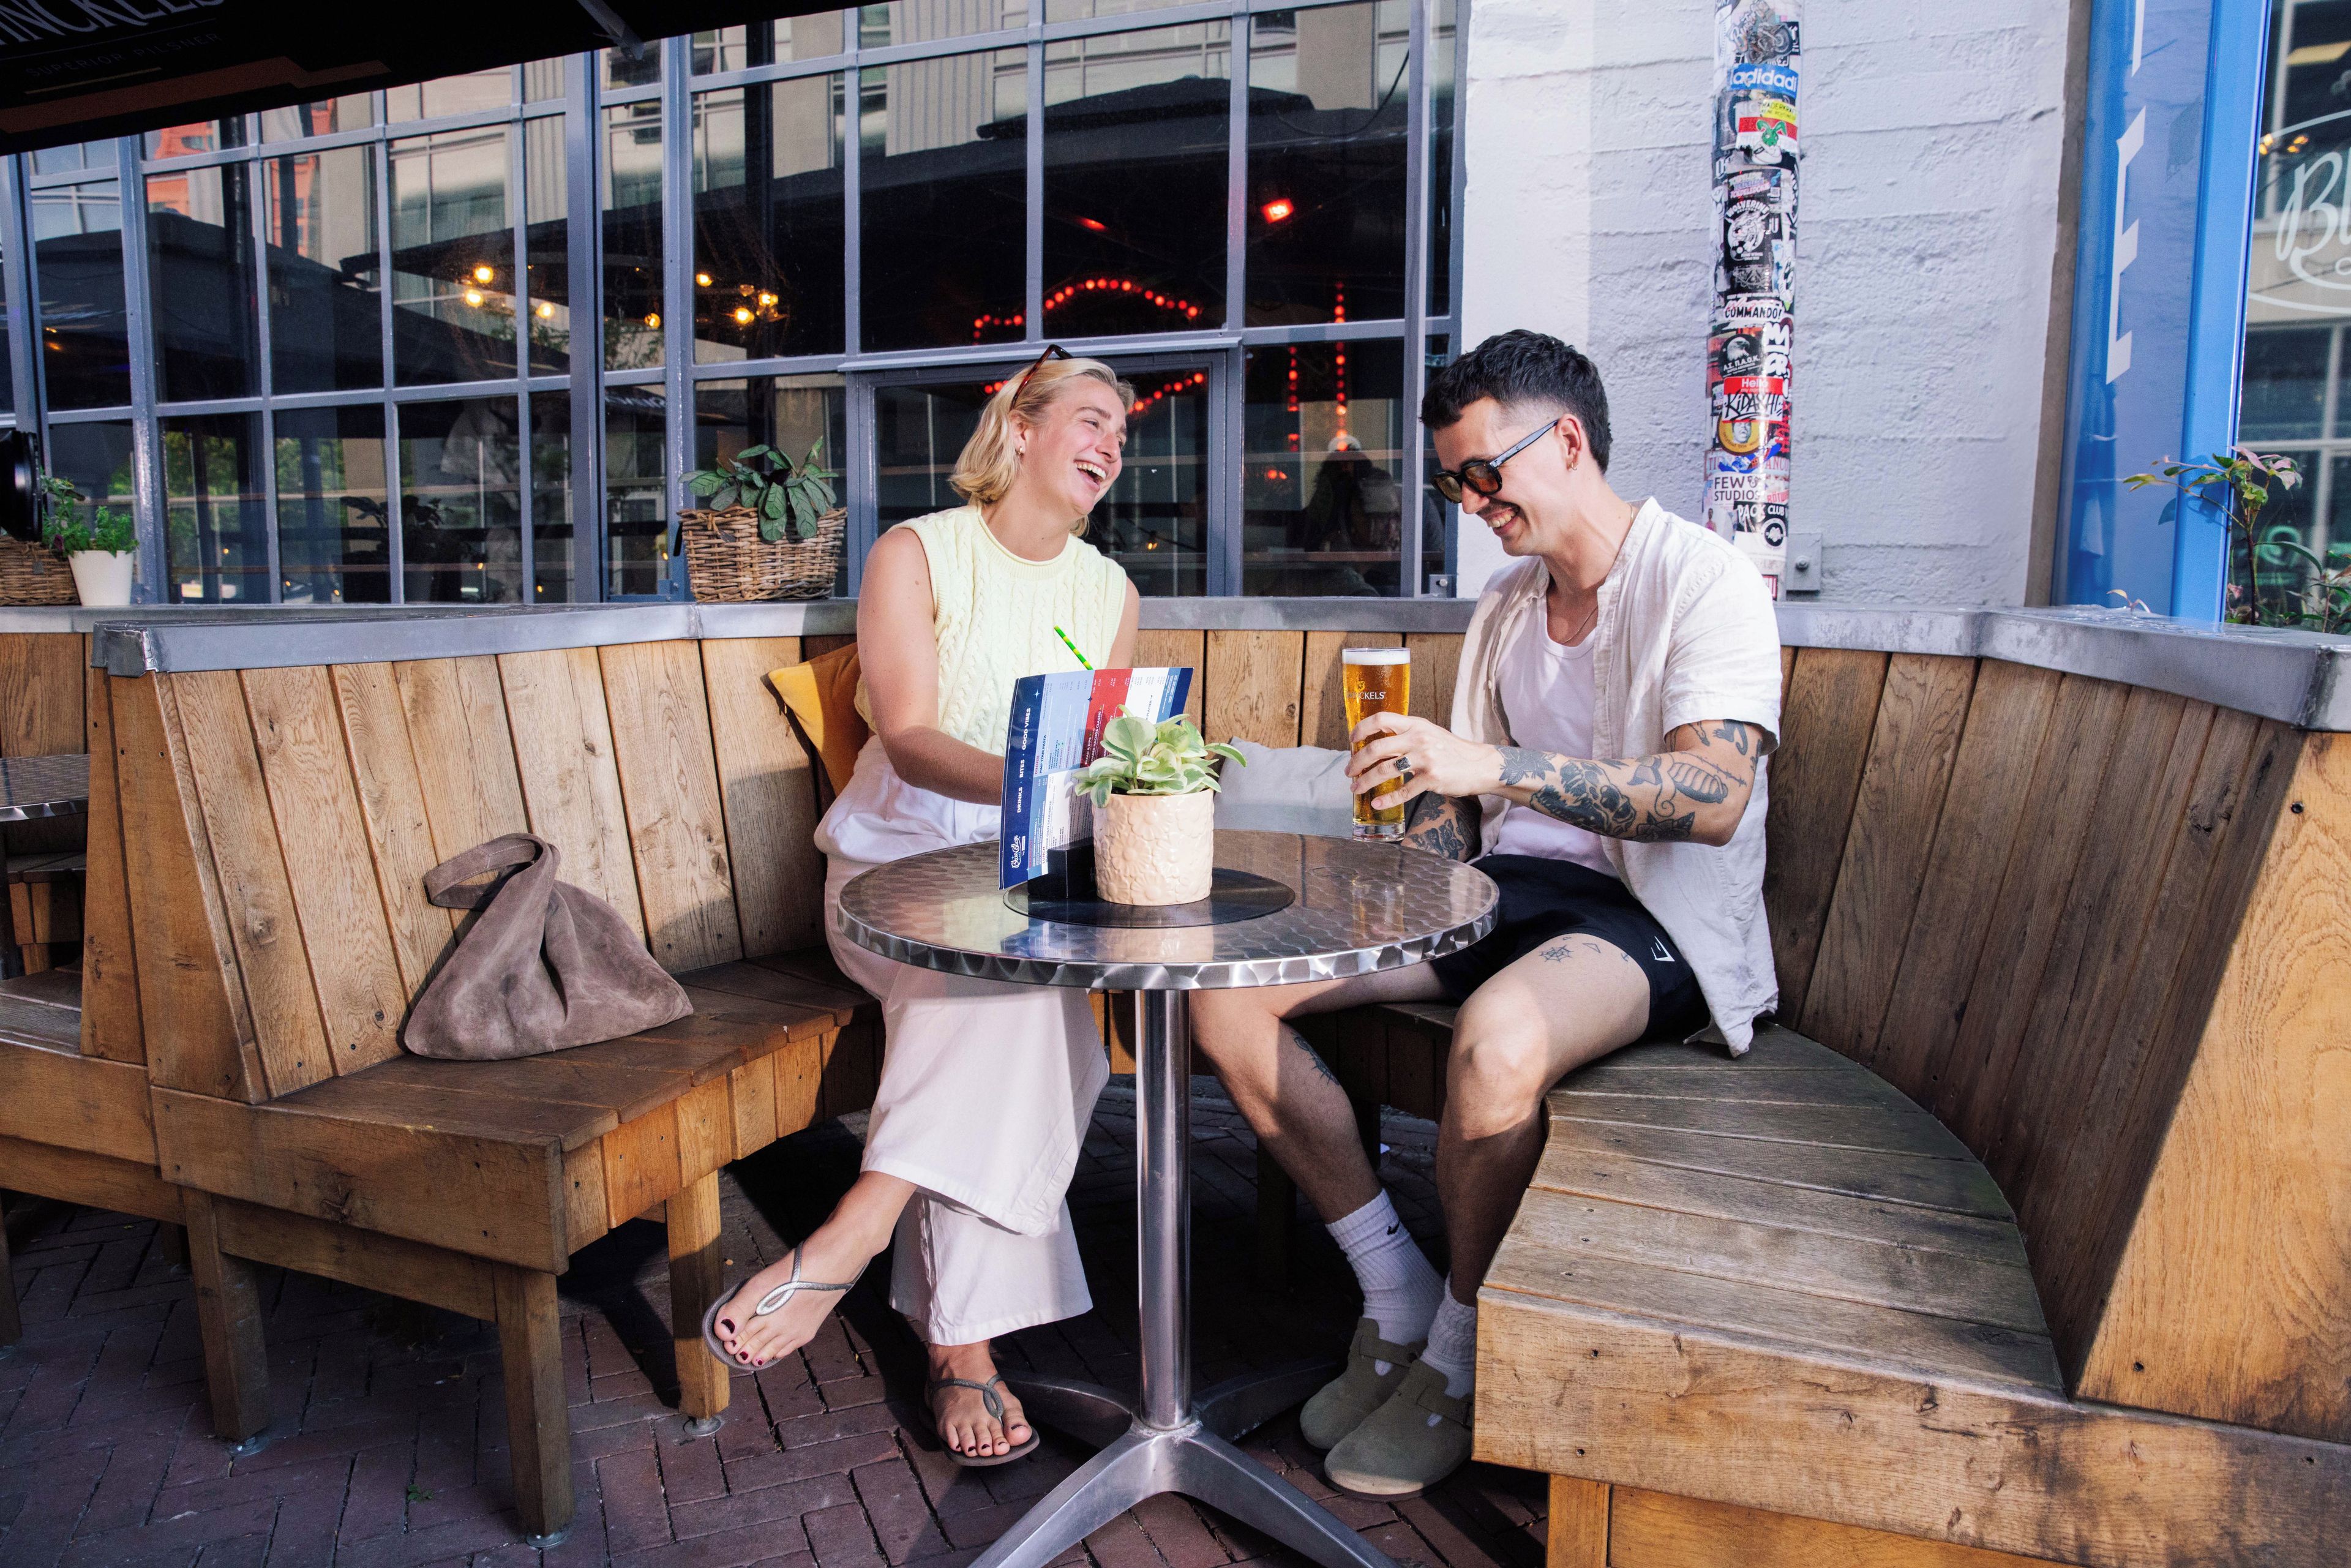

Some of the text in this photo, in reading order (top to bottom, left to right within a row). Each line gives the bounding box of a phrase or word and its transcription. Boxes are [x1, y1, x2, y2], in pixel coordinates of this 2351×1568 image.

[25, 32, 223, 78] SUPERIOR PILSNER
[1725, 306, 1783, 320] COMMANDO!
[1741, 378, 1769, 388] Hello
[1714, 476, 1745, 489] FEW
[1714, 490, 1760, 501] STUDIOS
[1768, 505, 1785, 516] CLUB
[1347, 691, 1386, 700] CKELS'
[1010, 835, 1020, 868] Blue Collar
